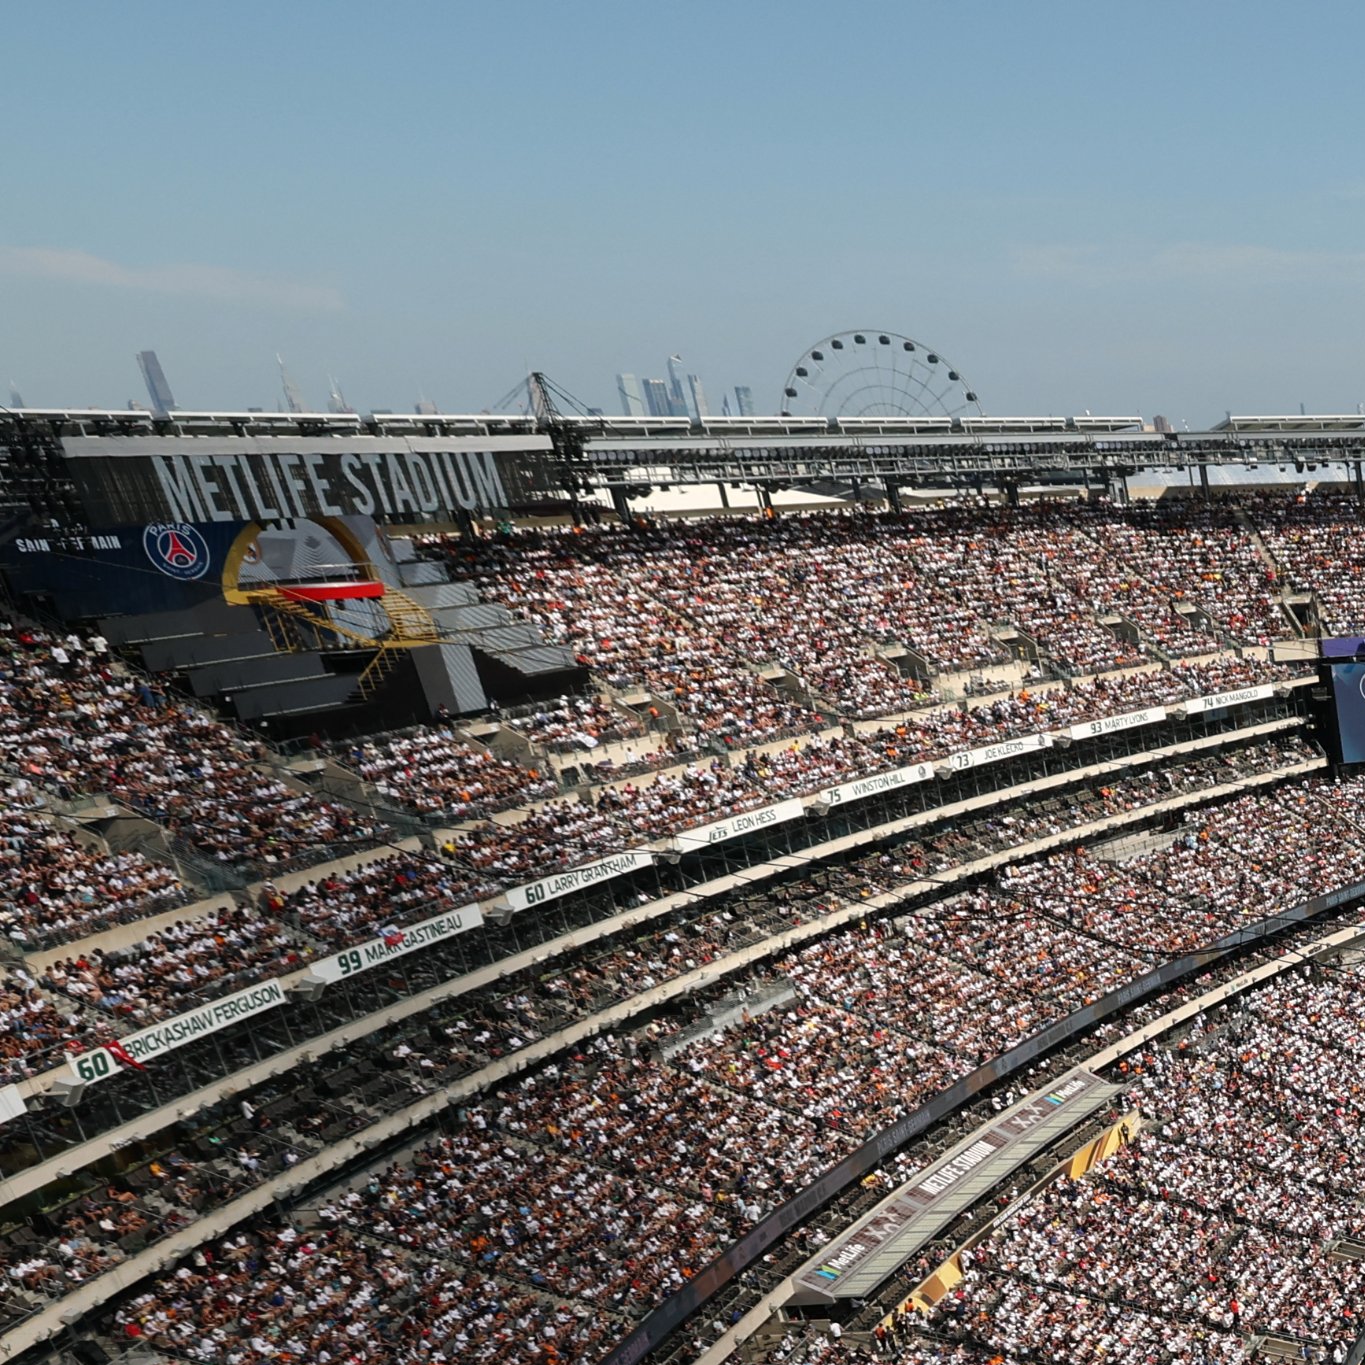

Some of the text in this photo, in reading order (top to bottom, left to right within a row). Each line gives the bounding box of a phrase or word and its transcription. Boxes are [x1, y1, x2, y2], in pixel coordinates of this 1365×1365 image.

[152, 451, 509, 524] METLIFE STADIUM
[1202, 697, 1214, 708] 74
[1229, 689, 1260, 704] MANGOLD
[1090, 711, 1149, 734] 93 MARTY LYONS
[957, 755, 970, 769] 73
[996, 741, 1024, 758] KLECKO
[827, 772, 906, 803] 75 WINSTON HILL
[708, 808, 777, 844] JETS LEON HESS
[525, 855, 637, 904] 60 LARRY GRANTHAM
[337, 950, 362, 975] 99
[401, 914, 464, 953] GASTINEAU
[76, 1053, 109, 1081] 60
[213, 982, 283, 1025] FERGUSON
[1056, 1081, 1086, 1099] MetLife
[918, 1140, 996, 1195] METLIFE STADIUM
[828, 1243, 865, 1270] MetLife
